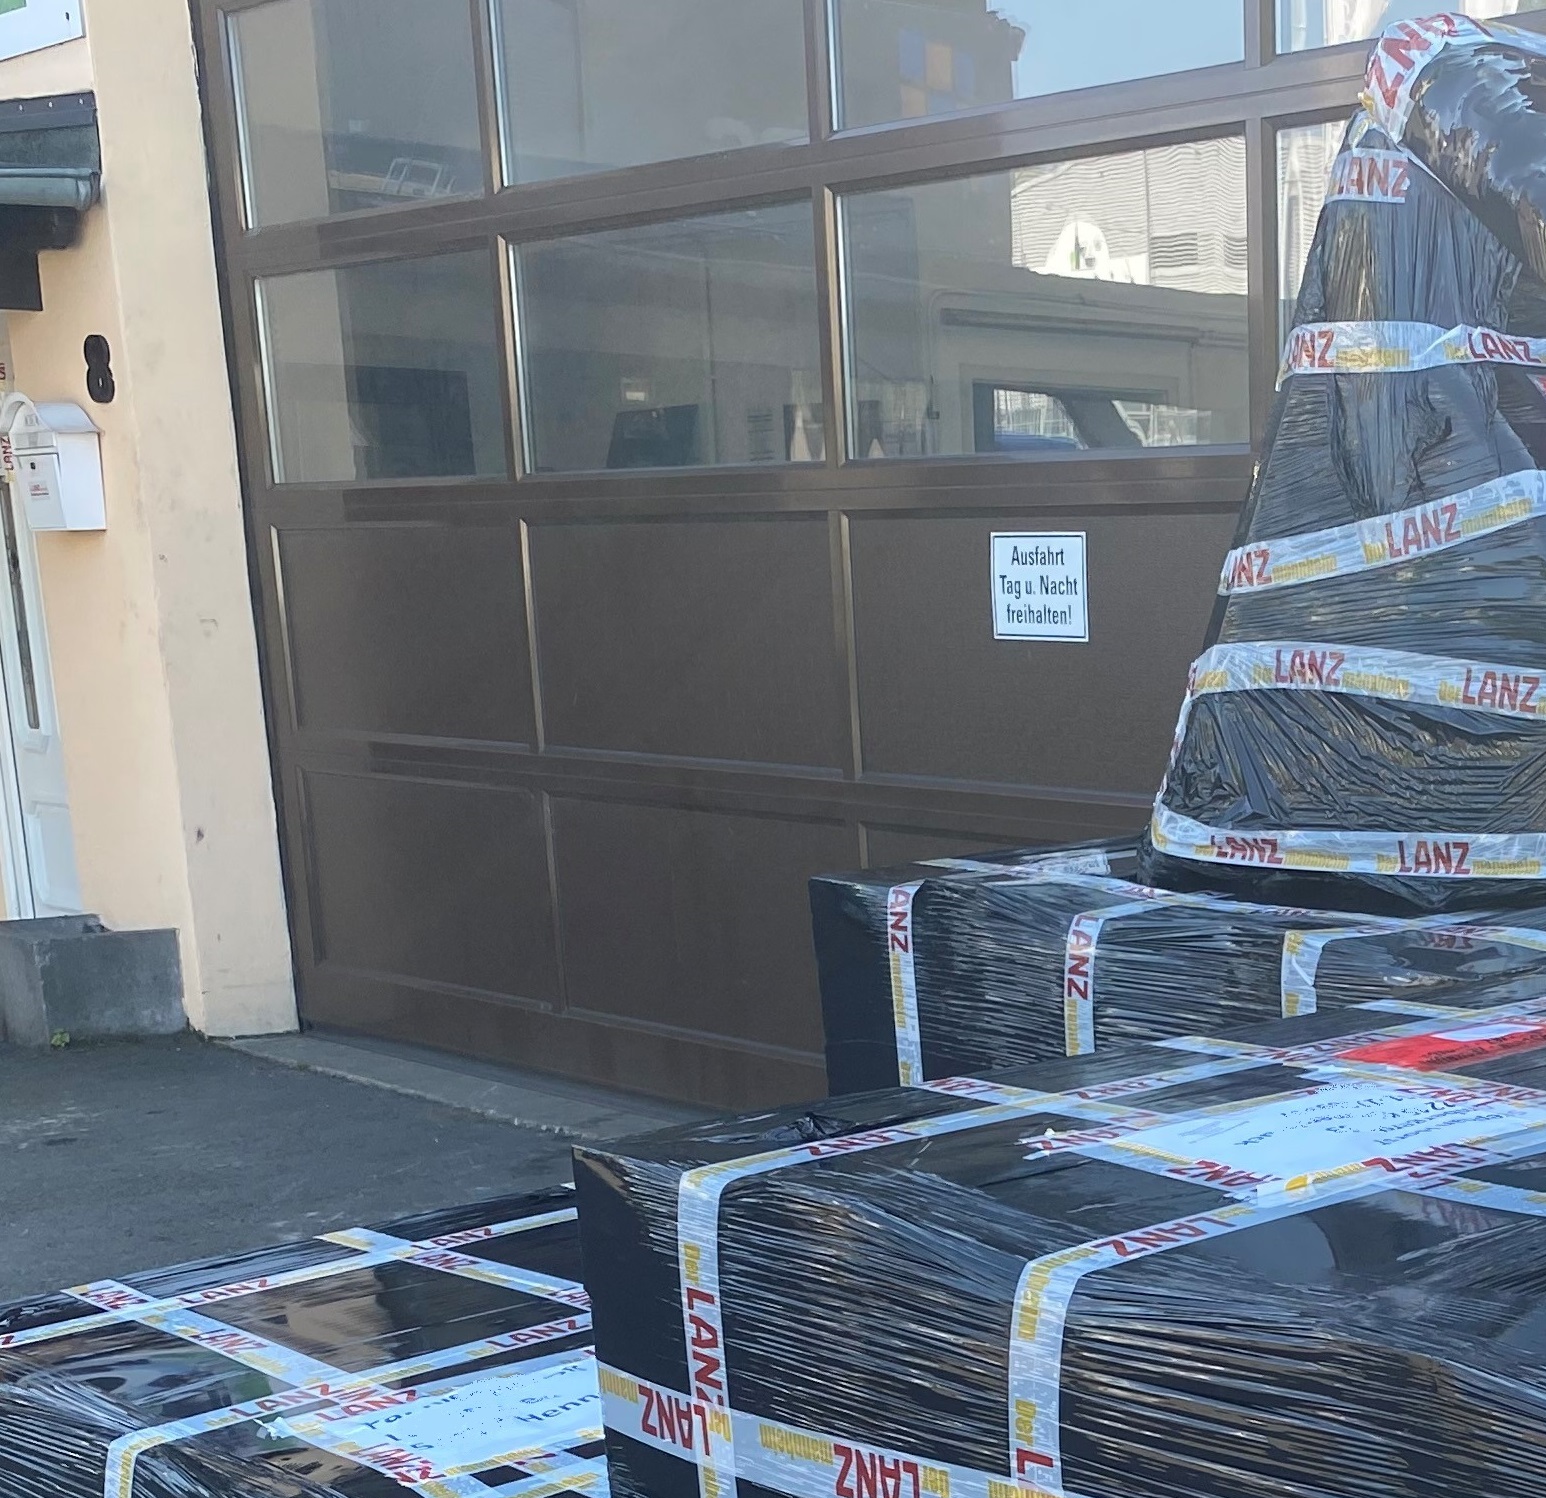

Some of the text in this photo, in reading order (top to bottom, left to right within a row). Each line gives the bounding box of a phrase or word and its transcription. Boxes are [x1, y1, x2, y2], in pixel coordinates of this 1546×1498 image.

[1469, 331, 1537, 363] LANZ
[84, 334, 116, 404] 8
[1389, 503, 1457, 557] LANZ
[1010, 545, 1066, 567] Ausfahrt
[999, 574, 1079, 600] Tag u. Nacht
[1006, 603, 1073, 626] freihalten!
[1275, 650, 1343, 685] LANZ
[1462, 671, 1539, 713] LANZ
[1211, 836, 1284, 866] LANZ
[1400, 841, 1470, 876] LANZ
[1068, 914, 1099, 998] LANZ
[805, 1124, 919, 1156] LANZ
[412, 1227, 500, 1248] LANZ
[1096, 1213, 1238, 1256] LANZ
[176, 1276, 288, 1303] LANZ
[486, 1320, 590, 1349] LANZ
[315, 1390, 421, 1422] LANZ
[638, 1380, 714, 1454] LANZ
[1016, 1401, 1035, 1443] Der
